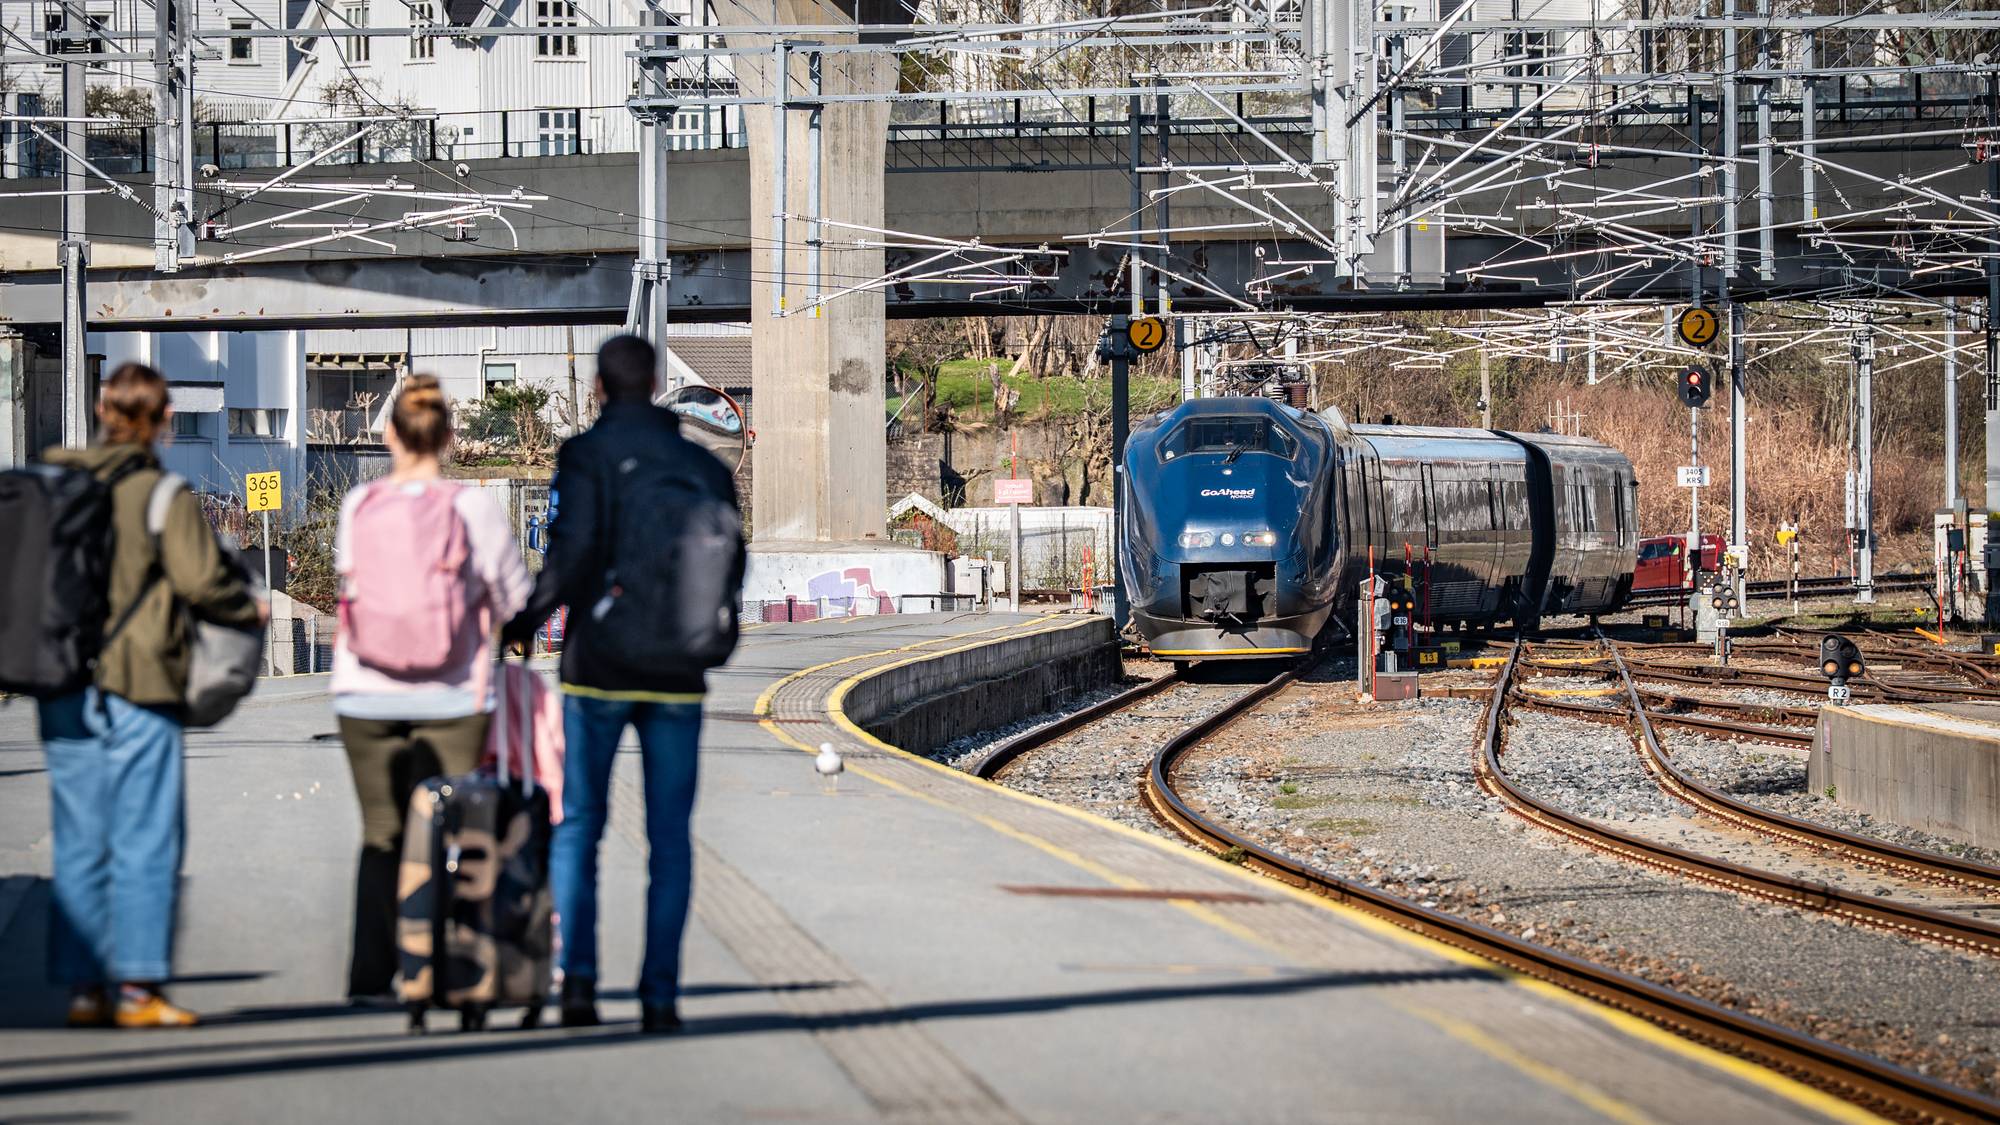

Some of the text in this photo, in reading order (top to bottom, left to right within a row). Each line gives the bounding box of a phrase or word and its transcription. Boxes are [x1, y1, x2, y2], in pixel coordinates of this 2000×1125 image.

[1692, 314, 1705, 338] 2
[1140, 322, 1153, 346] 2
[249, 475, 278, 491] 365
[259, 492, 269, 507] 5
[1200, 488, 1256, 497] GoAhead
[1424, 654, 1434, 662] 13
